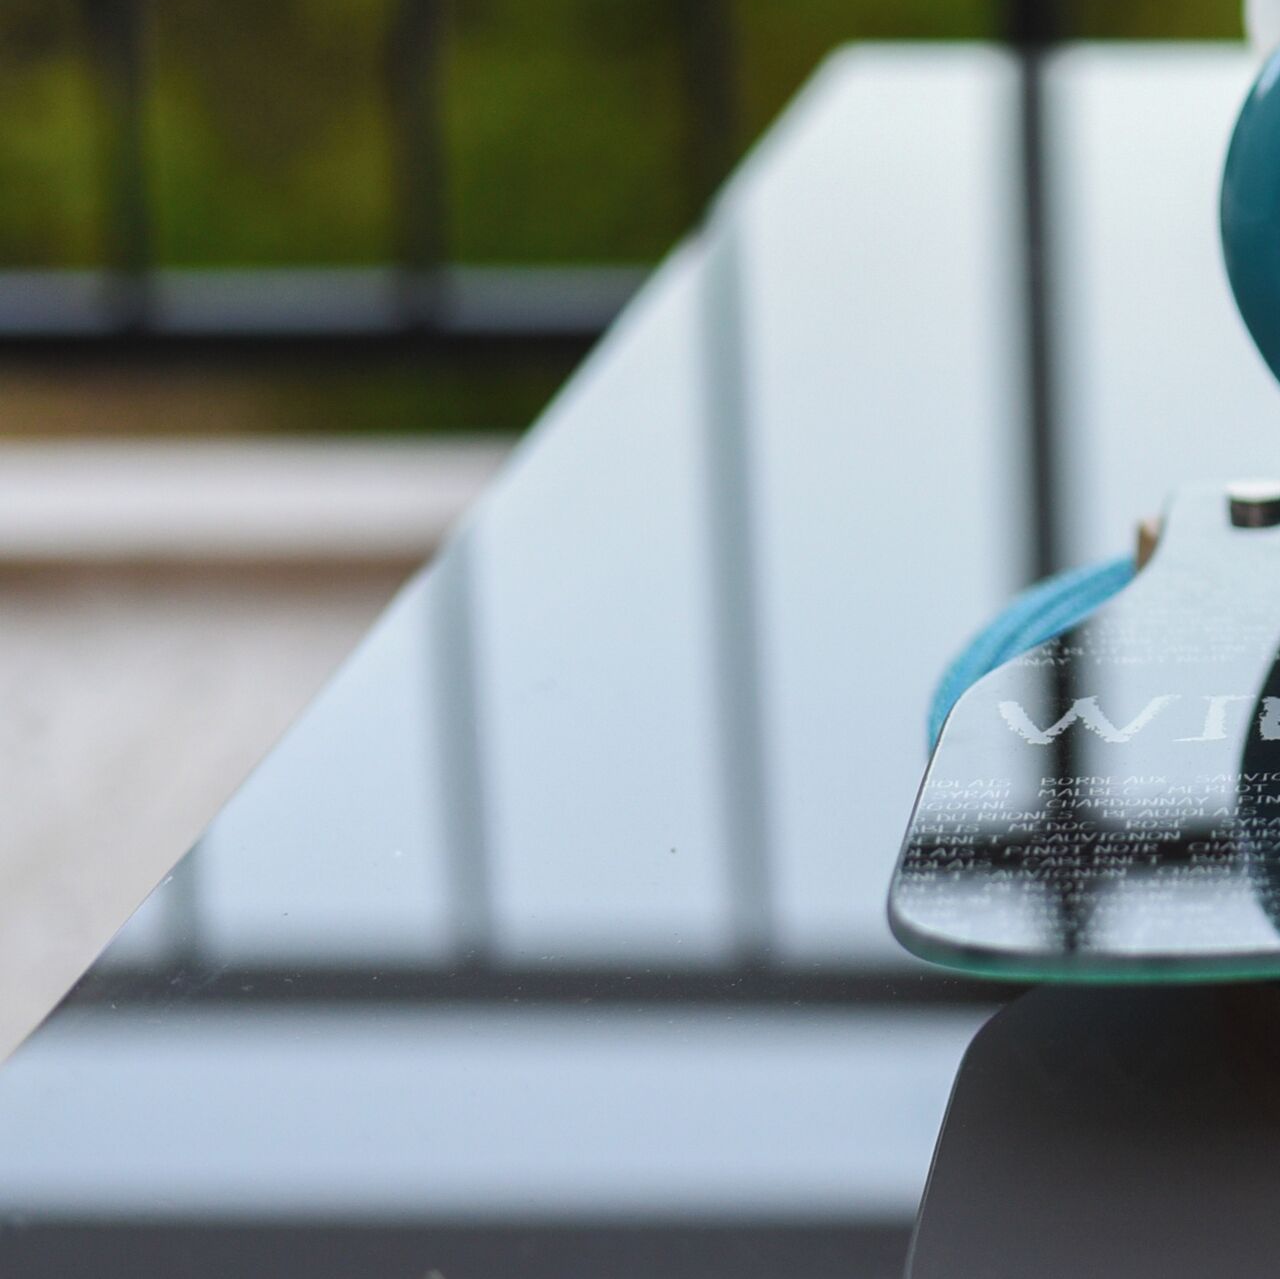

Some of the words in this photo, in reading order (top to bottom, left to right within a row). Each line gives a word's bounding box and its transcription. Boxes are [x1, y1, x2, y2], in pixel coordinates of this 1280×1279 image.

[1041, 775, 1167, 787] BORDEAUX
[1037, 785, 1136, 798] MALBEC
[1168, 783, 1268, 795] MERLOT
[1045, 796, 1209, 809] CHARDONNAY
[1103, 805, 1258, 819] BEAUJOLAIS
[1032, 831, 1181, 844] SAUVIGNON
[1004, 844, 1087, 858] PINOT
[1094, 842, 1160, 855] NOIR
